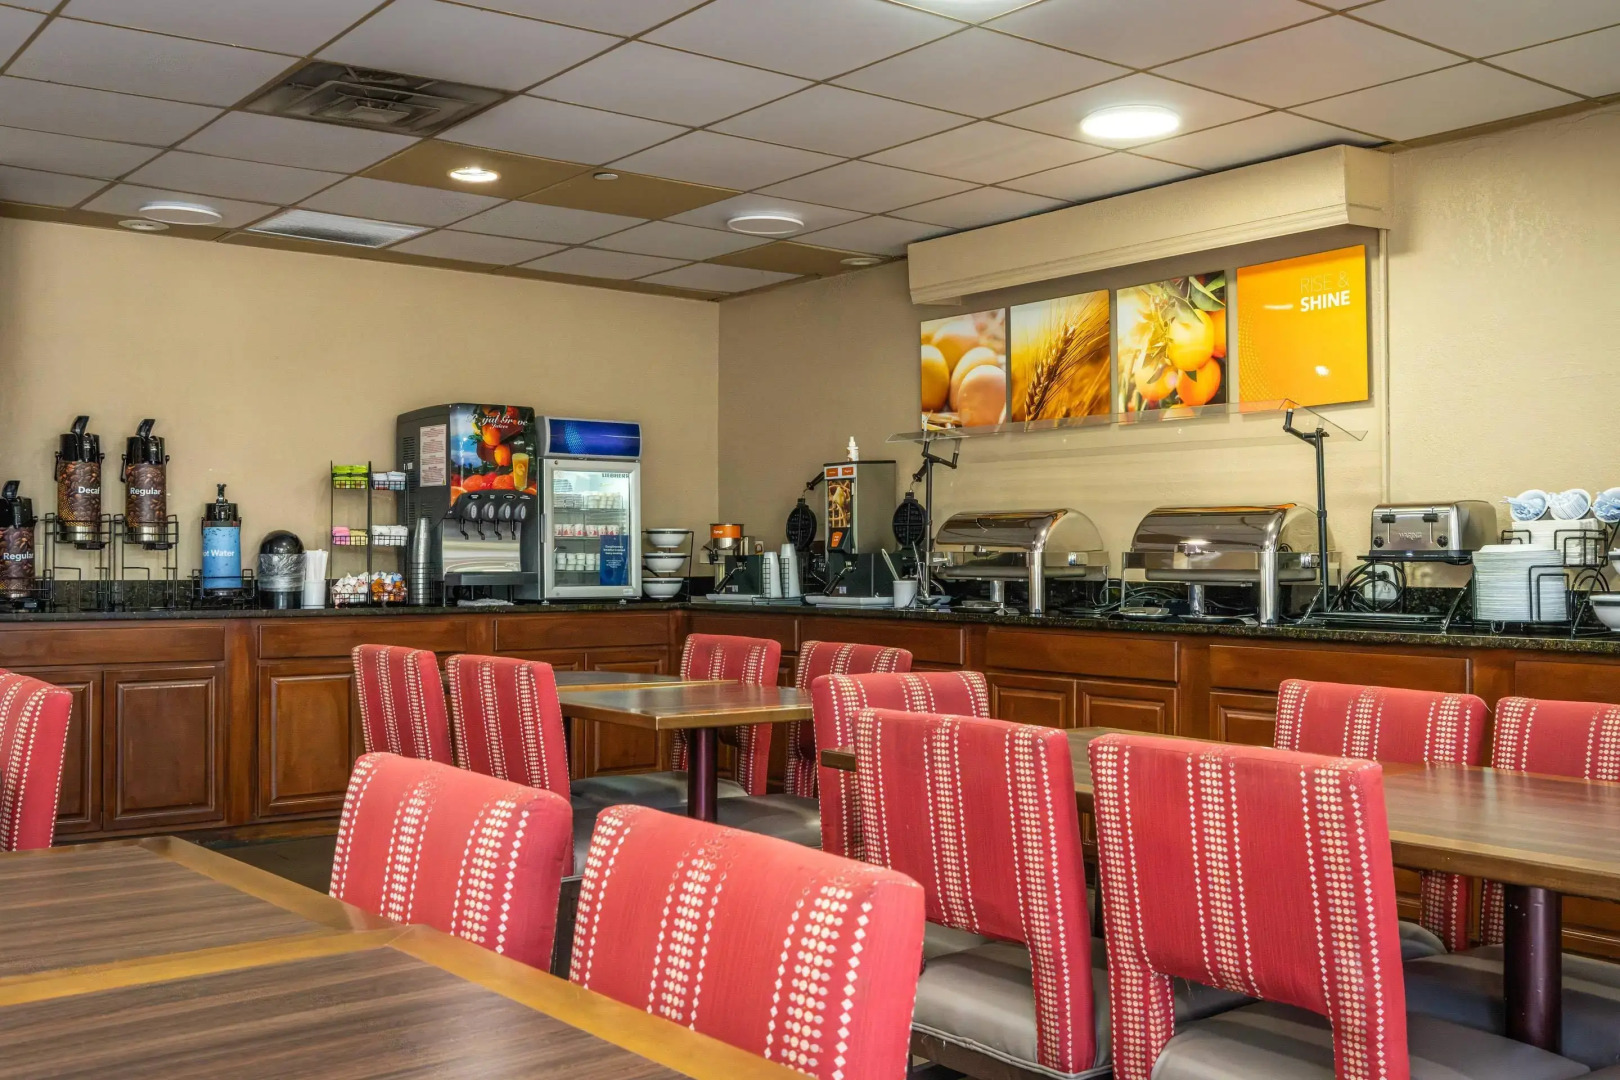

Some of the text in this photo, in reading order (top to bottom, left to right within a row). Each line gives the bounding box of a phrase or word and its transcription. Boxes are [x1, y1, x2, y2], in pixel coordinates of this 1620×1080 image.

[1300, 270, 1350, 294] RISE &
[1300, 290, 1350, 312] SHINE
[78, 486, 100, 495] Decaf
[130, 486, 161, 497] Regular
[3, 551, 34, 562] Regular
[210, 549, 235, 557] Water
